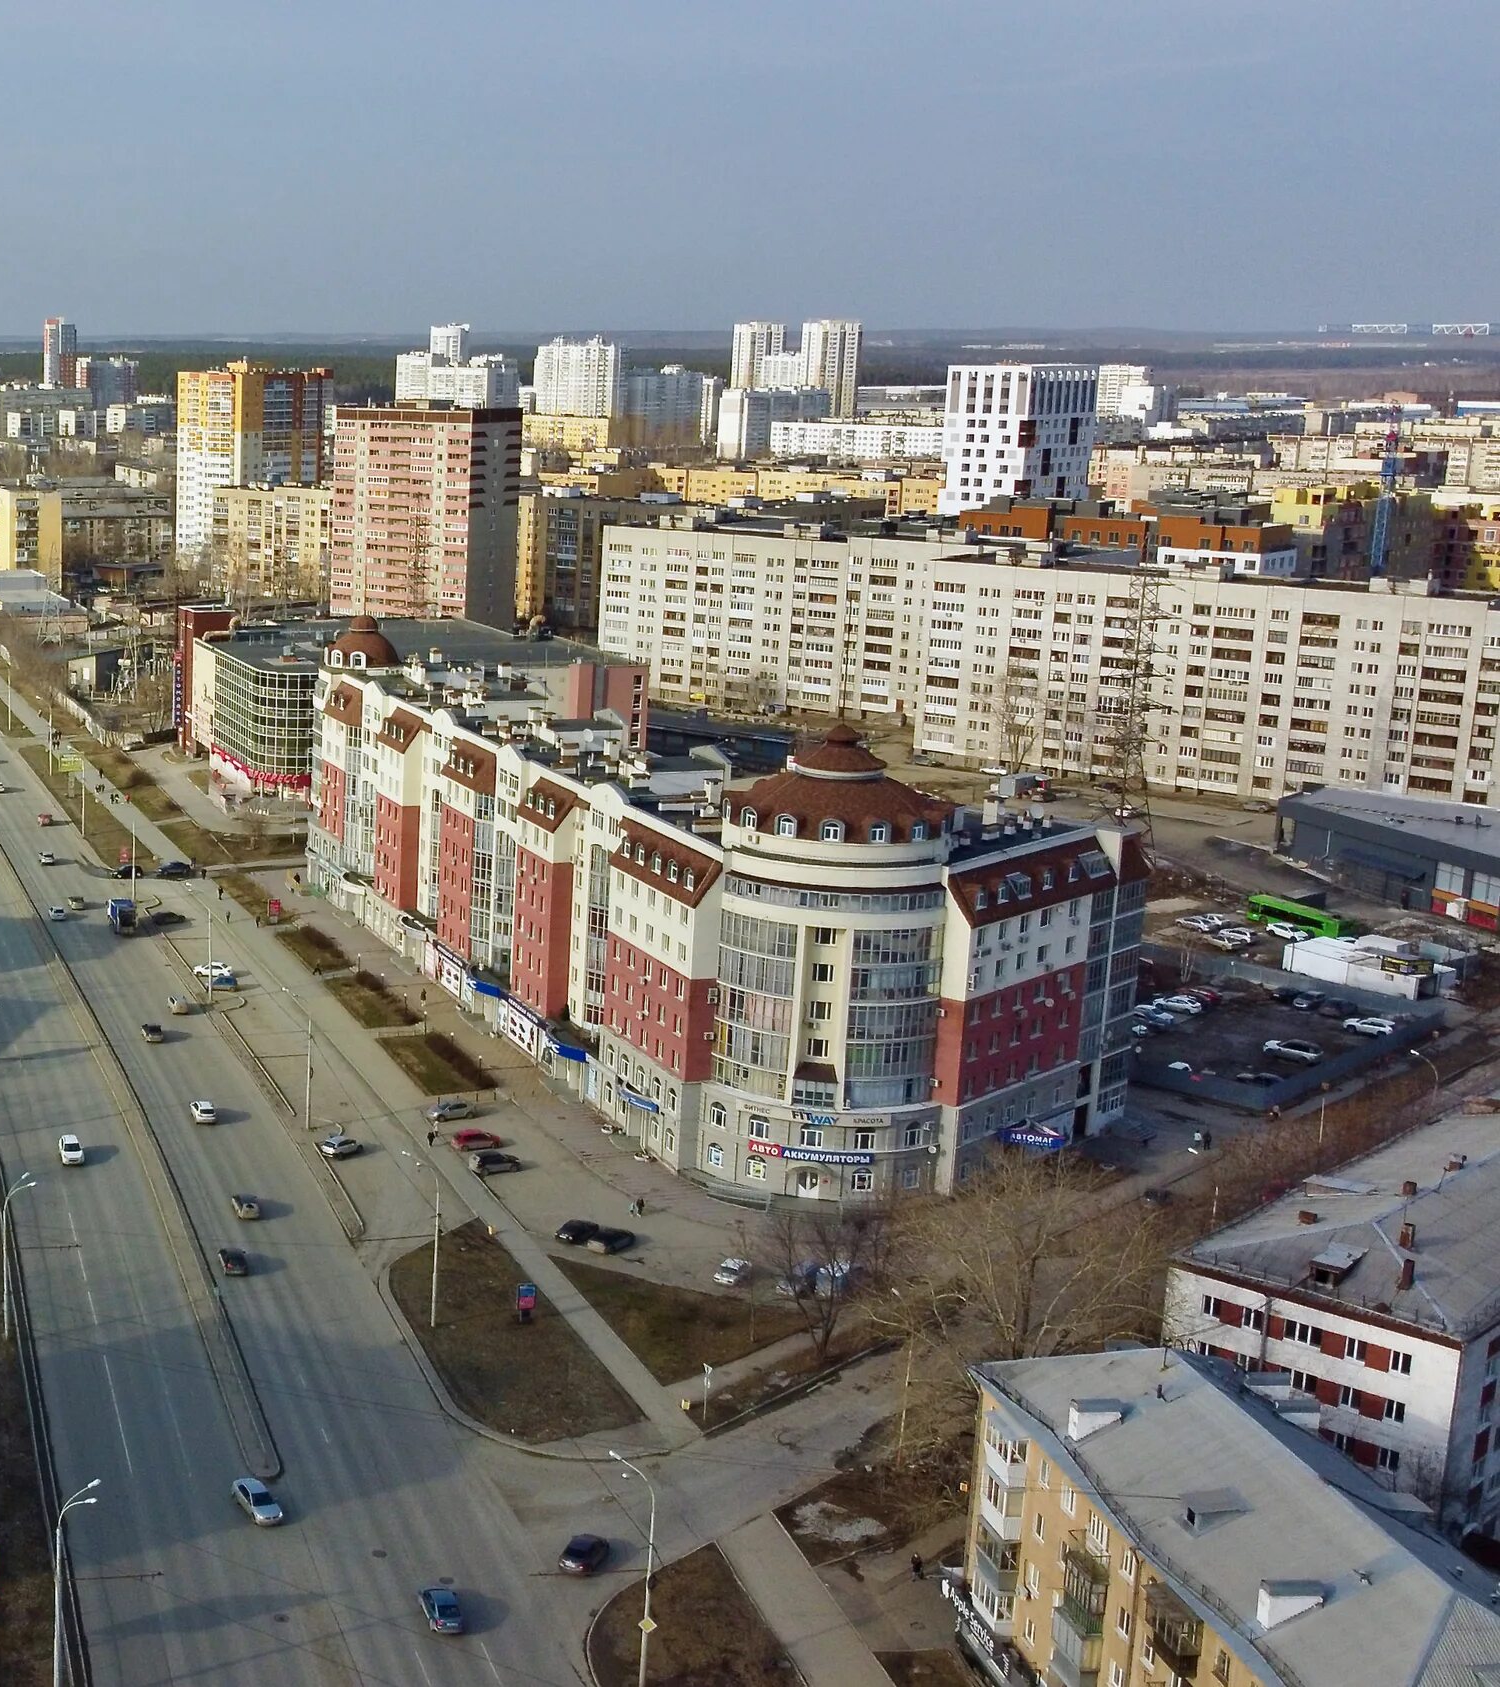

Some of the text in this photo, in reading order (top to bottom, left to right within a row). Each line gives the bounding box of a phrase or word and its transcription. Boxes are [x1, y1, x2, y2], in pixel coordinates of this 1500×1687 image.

[744, 1104, 770, 1114] ФИТНЕС
[791, 1110, 839, 1125] FITWAY
[751, 1143, 870, 1164] АВТО АККУМУЛЯТОРЫ
[950, 1587, 969, 1619] Apple
[970, 1611, 994, 1650] Service
